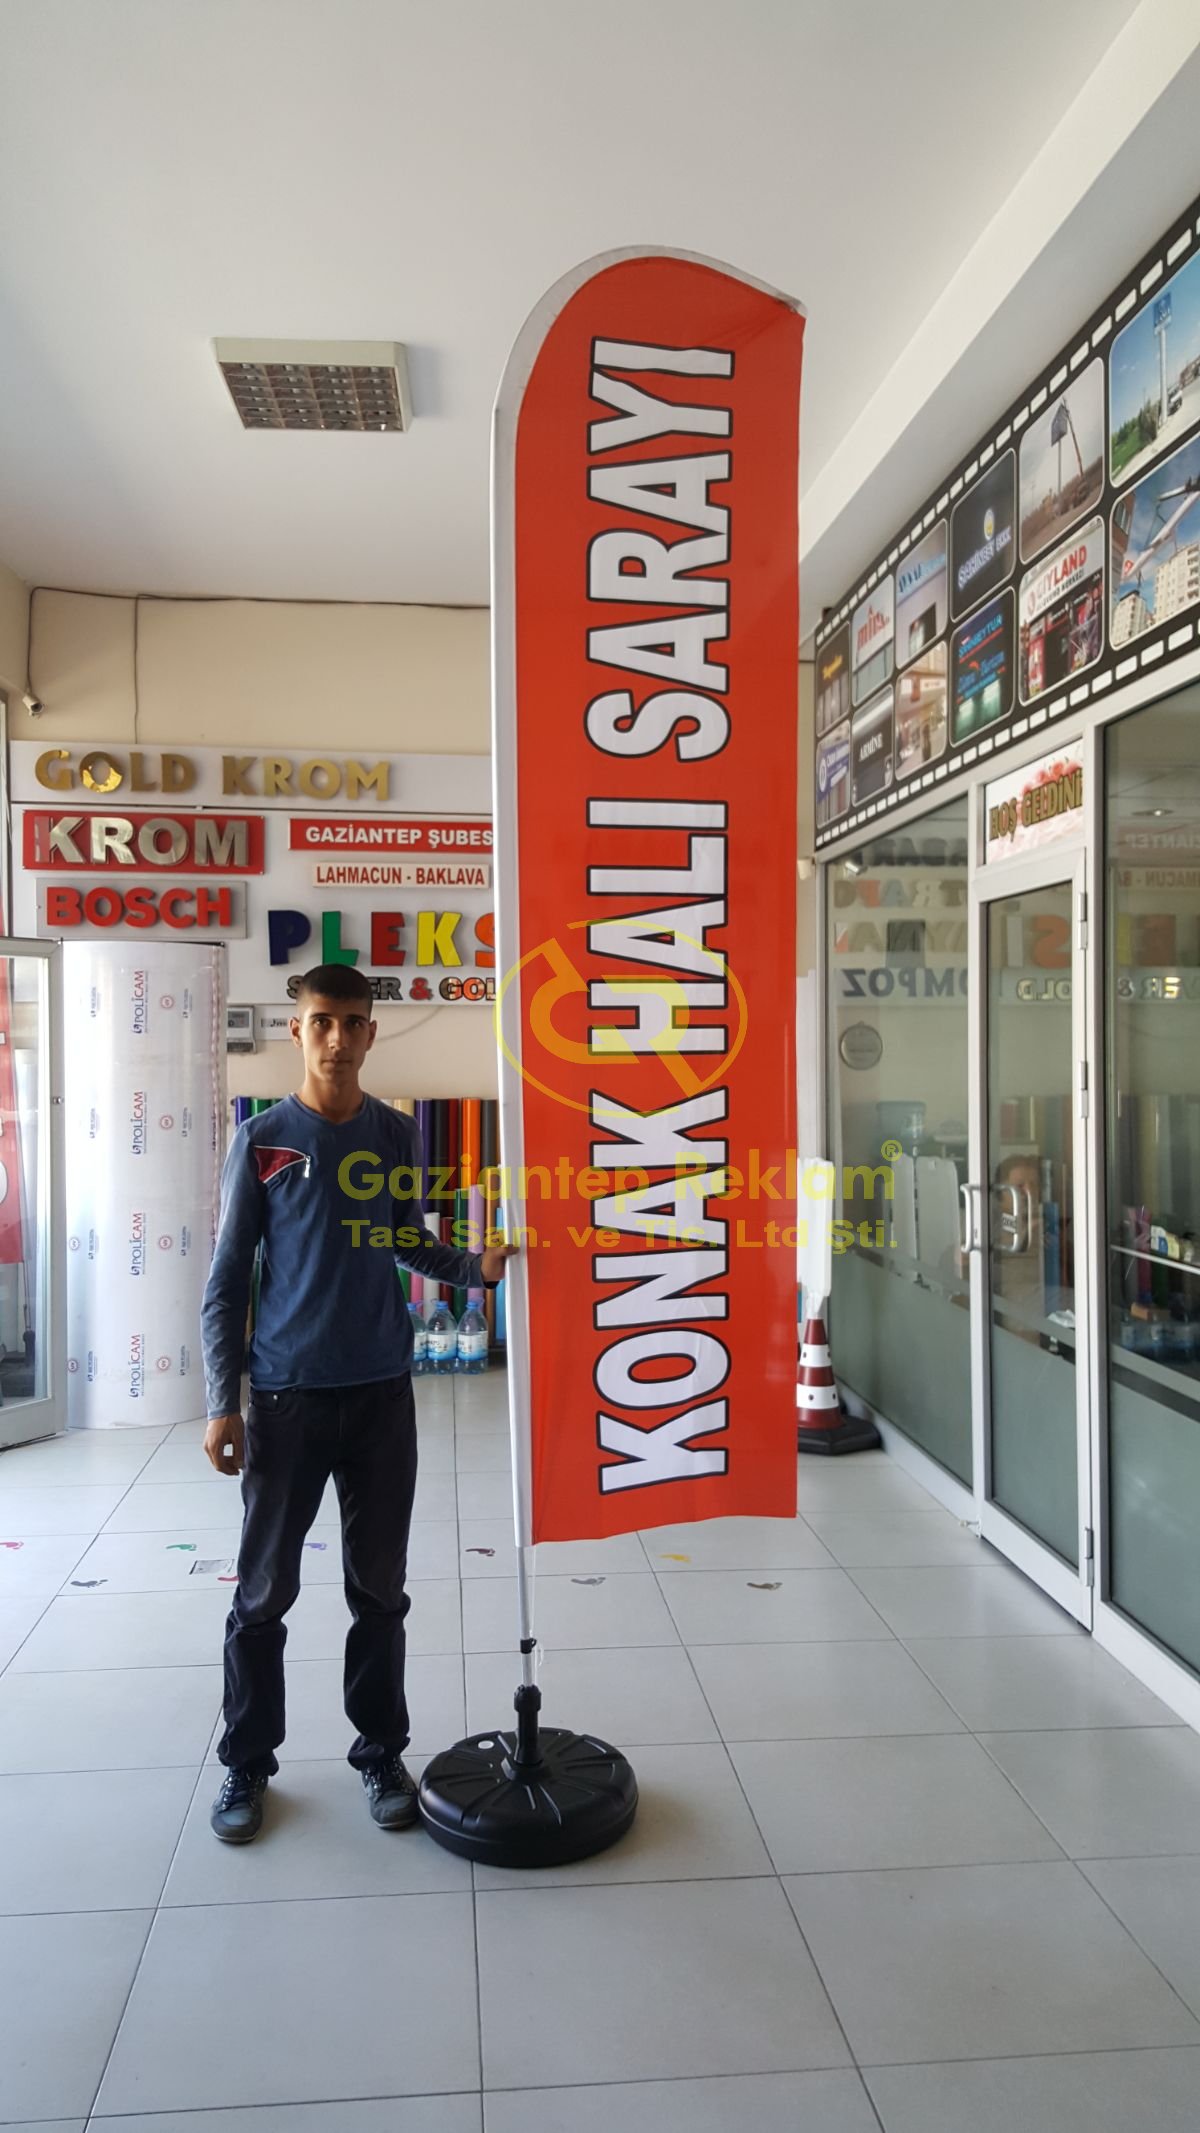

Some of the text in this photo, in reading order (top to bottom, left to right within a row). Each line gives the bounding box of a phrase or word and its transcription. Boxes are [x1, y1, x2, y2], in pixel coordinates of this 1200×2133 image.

[35, 749, 391, 801] GOLD KROM
[34, 816, 249, 867] KROM
[305, 824, 422, 844] GAZİANTEP
[316, 866, 402, 884] LAHMACUN
[416, 867, 485, 885] BAKLAVA
[46, 886, 232, 928] BOSCH
[584, 336, 736, 1493] KONAK HALI SARAYI
[131, 970, 145, 1023] POLİCAM
[409, 977, 431, 1000] &
[130, 1091, 144, 1143] POLİCAM
[129, 1212, 143, 1264] POLİCAM
[128, 1334, 141, 1387] POLİCAM
